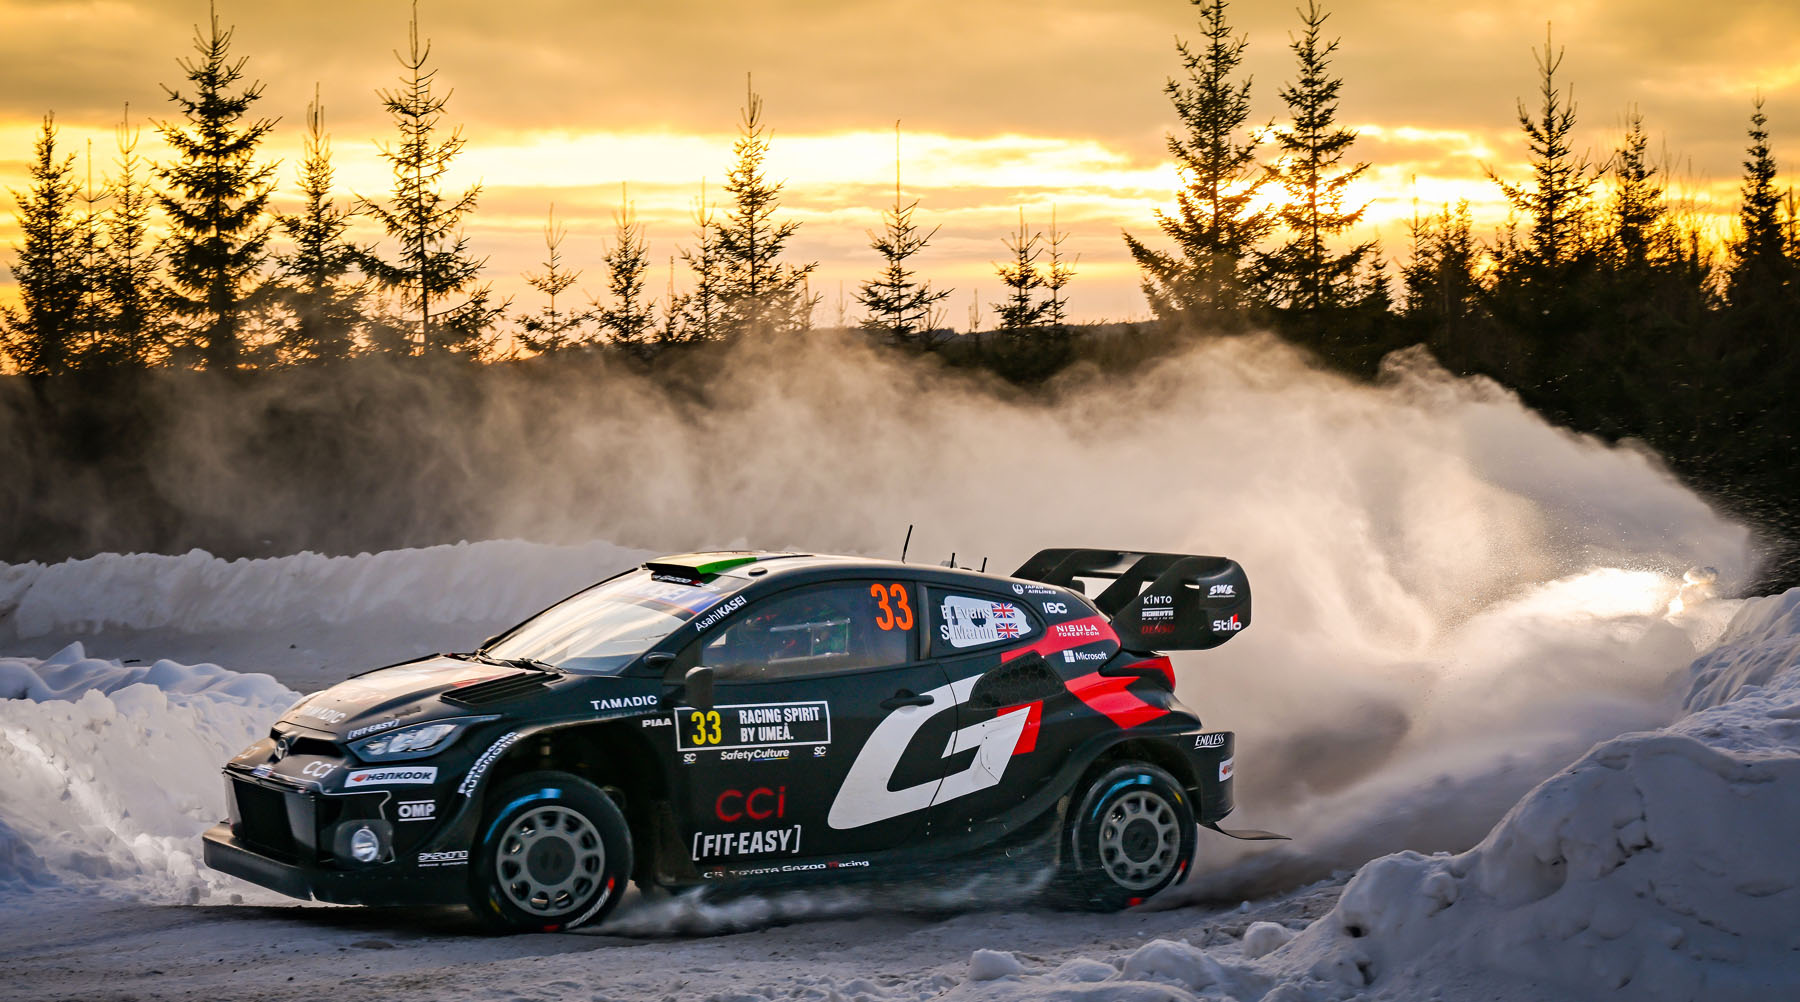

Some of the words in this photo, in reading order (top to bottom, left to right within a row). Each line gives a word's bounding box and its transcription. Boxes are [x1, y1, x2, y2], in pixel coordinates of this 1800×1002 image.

[870, 583, 914, 631] 33
[1056, 624, 1098, 632] NISULA
[1213, 614, 1242, 631] Stilo
[1075, 651, 1107, 660] Microsoft
[590, 695, 658, 710] TAMADIC
[642, 718, 672, 728] PIAA
[738, 709, 782, 725] RACING
[784, 707, 820, 723] SPIRIT
[691, 711, 722, 745] 33
[740, 728, 755, 743] BY
[1195, 734, 1225, 746] ENDLESS
[683, 753, 696, 763] SC
[720, 749, 790, 762] SafetyCulture
[814, 746, 826, 755] SC
[457, 731, 517, 794] Panasonic
[465, 733, 526, 797] AUTOMOTIVE
[398, 803, 436, 818] OMP
[729, 866, 779, 876] TOYOTA
[782, 862, 826, 872] GAZOO
